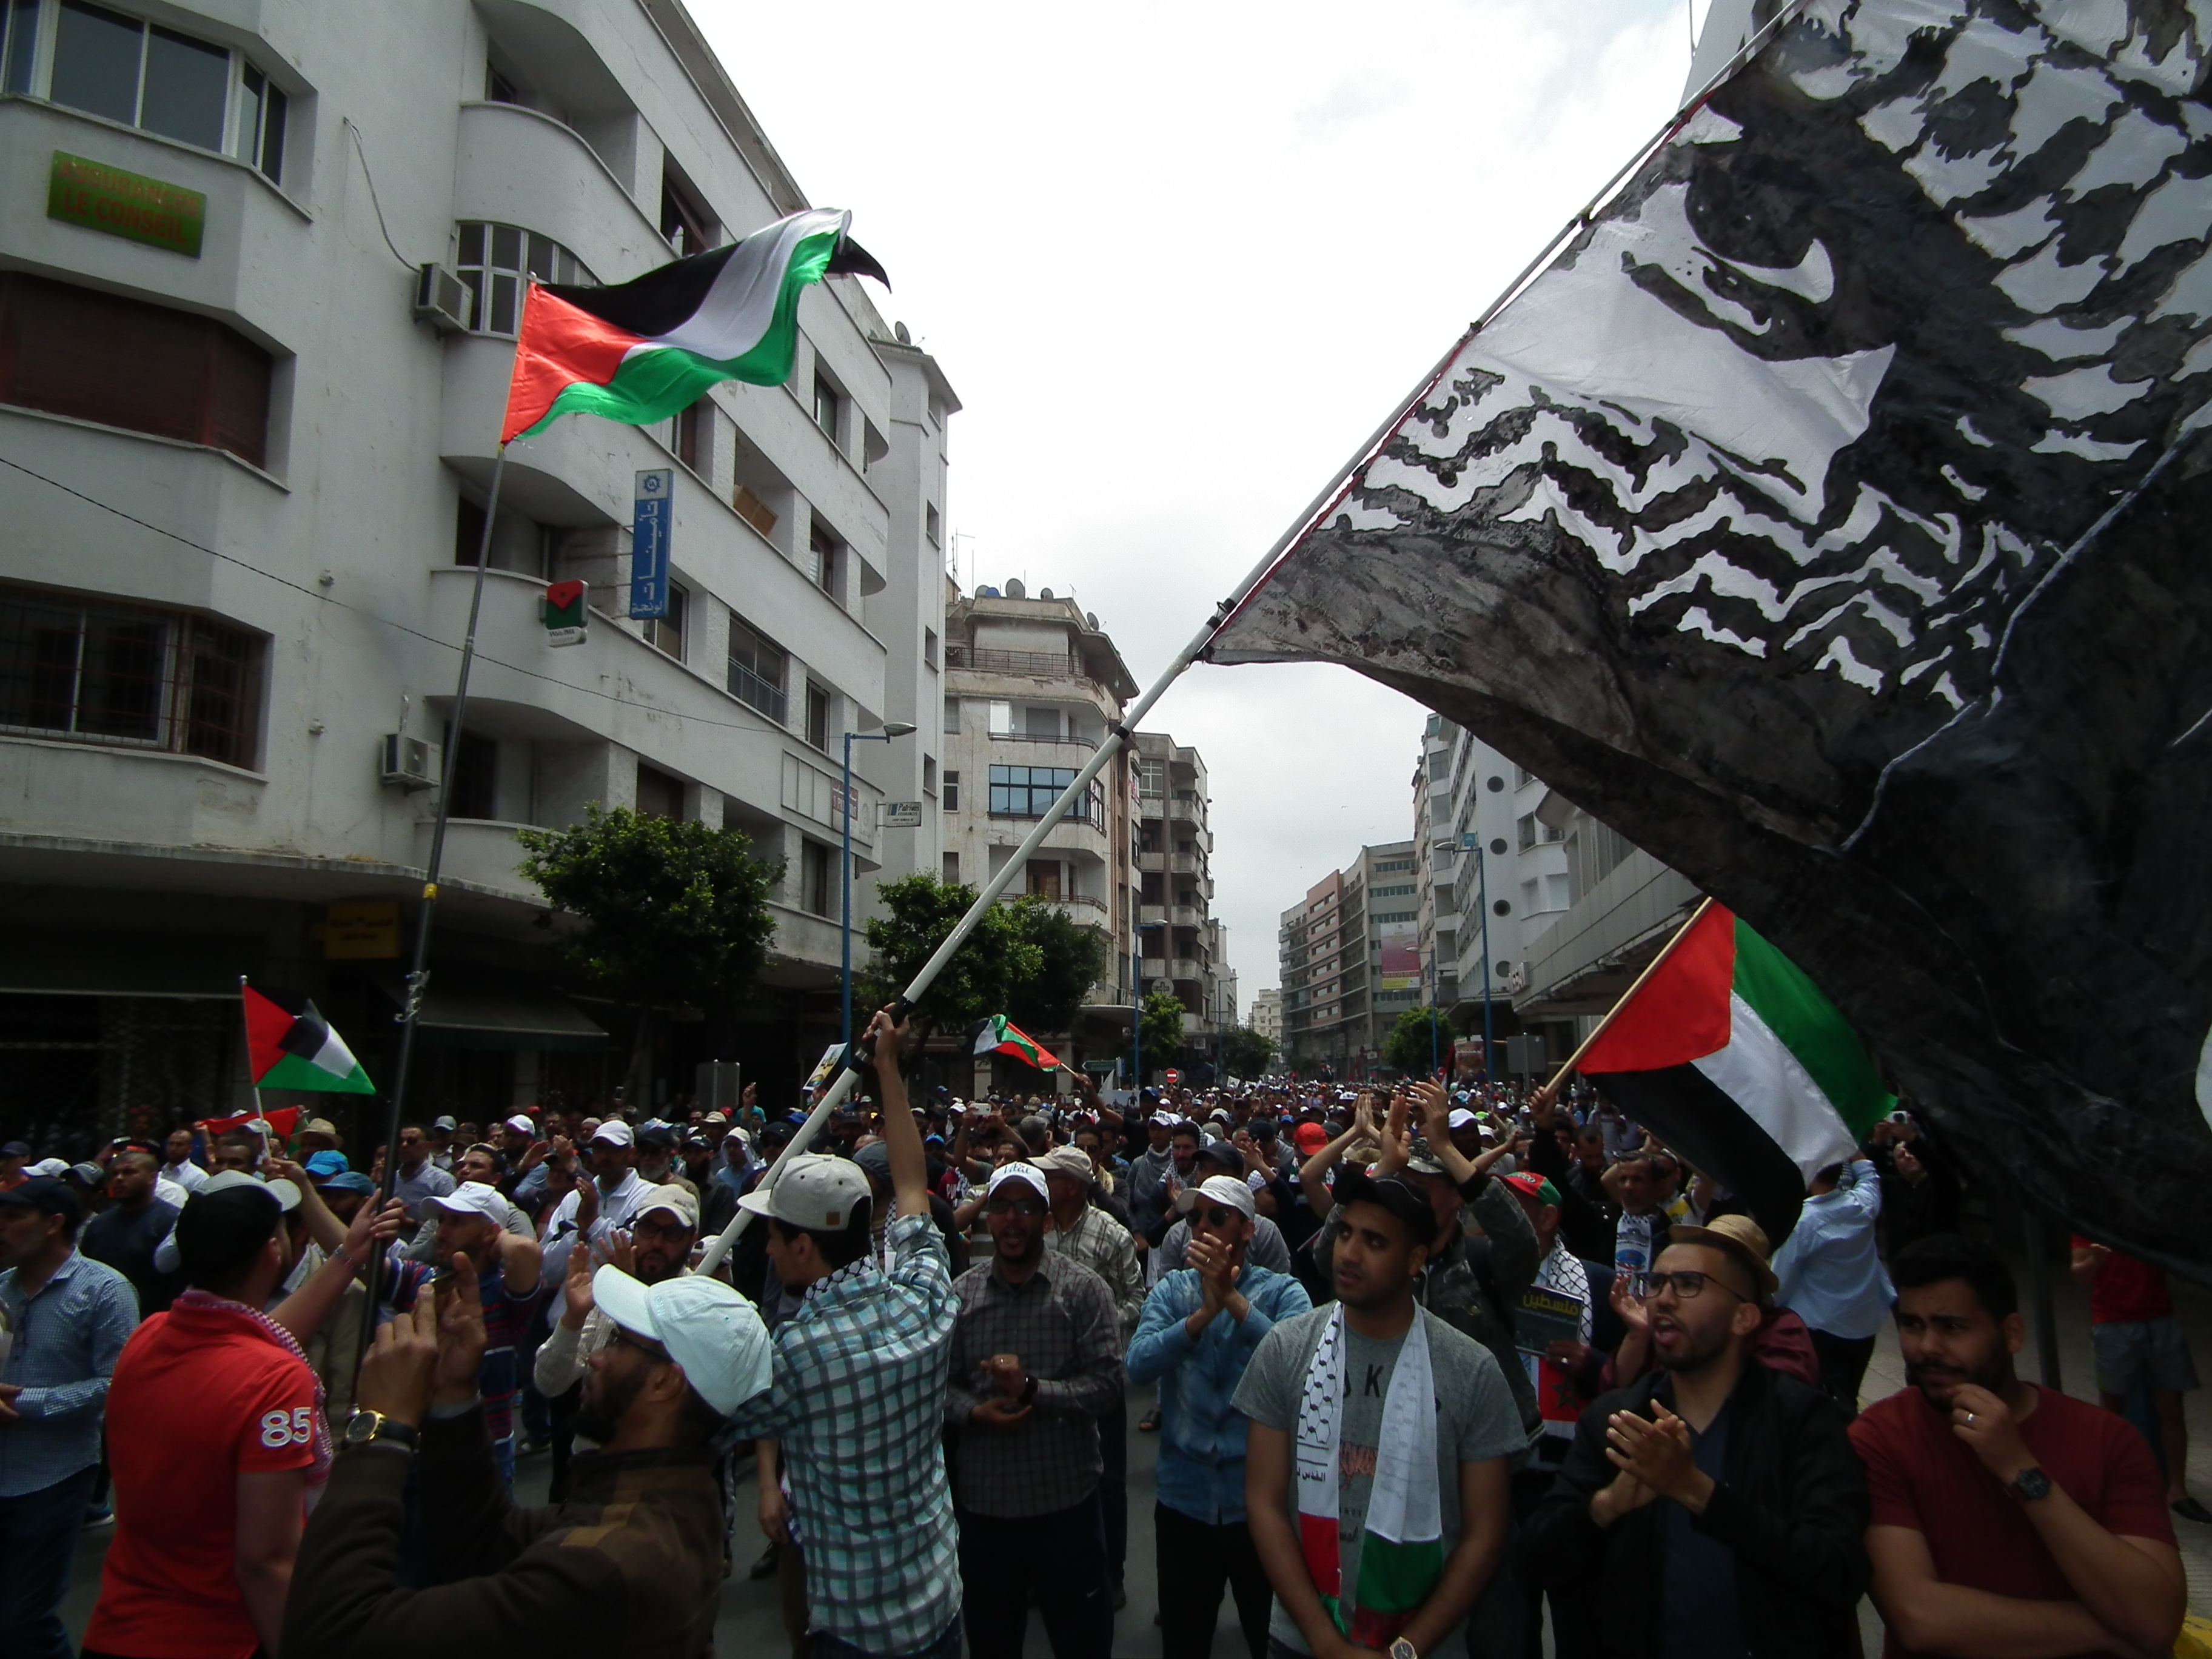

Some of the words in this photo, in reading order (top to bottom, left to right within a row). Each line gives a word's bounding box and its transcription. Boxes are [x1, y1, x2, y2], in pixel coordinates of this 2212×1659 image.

[58, 161, 199, 216] ASSURANCES
[63, 187, 89, 216] LE
[95, 197, 187, 243] CONSEIL
[1523, 1291, 1578, 1316] فلسطين
[262, 1407, 311, 1447] 85
